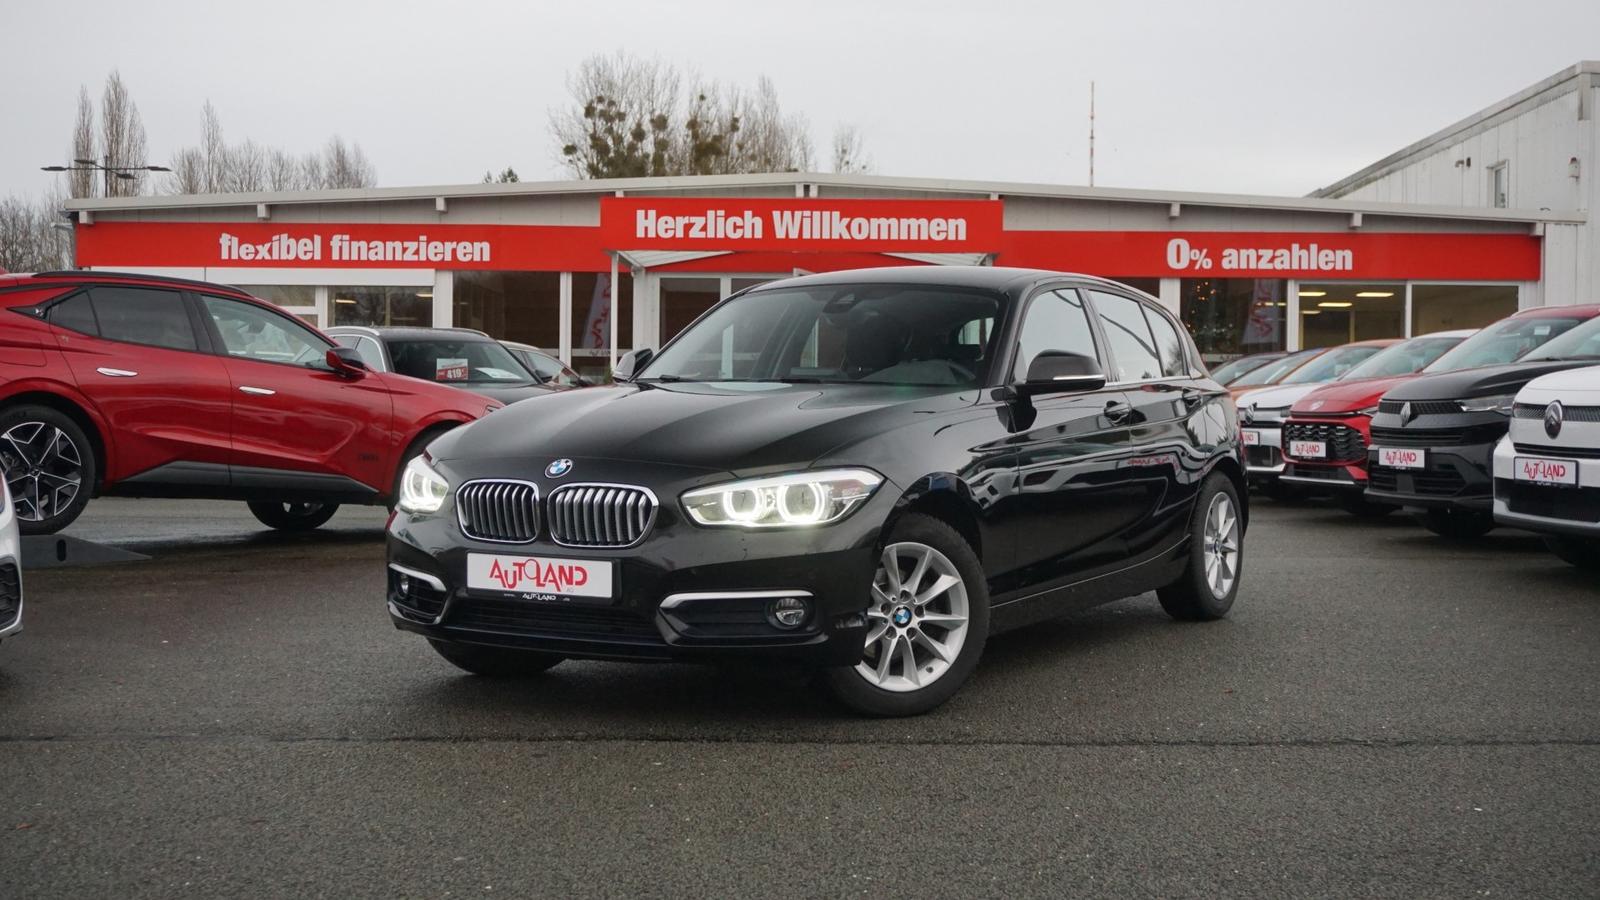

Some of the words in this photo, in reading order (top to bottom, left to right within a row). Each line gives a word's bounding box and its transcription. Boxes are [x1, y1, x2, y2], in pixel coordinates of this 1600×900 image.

[636, 209, 763, 239] Herzlich
[772, 210, 967, 241] Willkommen
[219, 233, 321, 261] flexibel
[330, 234, 491, 262] finanzieren
[1166, 238, 1213, 270] 0%
[1221, 243, 1353, 271] anzahlen
[1523, 460, 1566, 481] AUTOLAND
[489, 557, 588, 593] AUTOLAND
